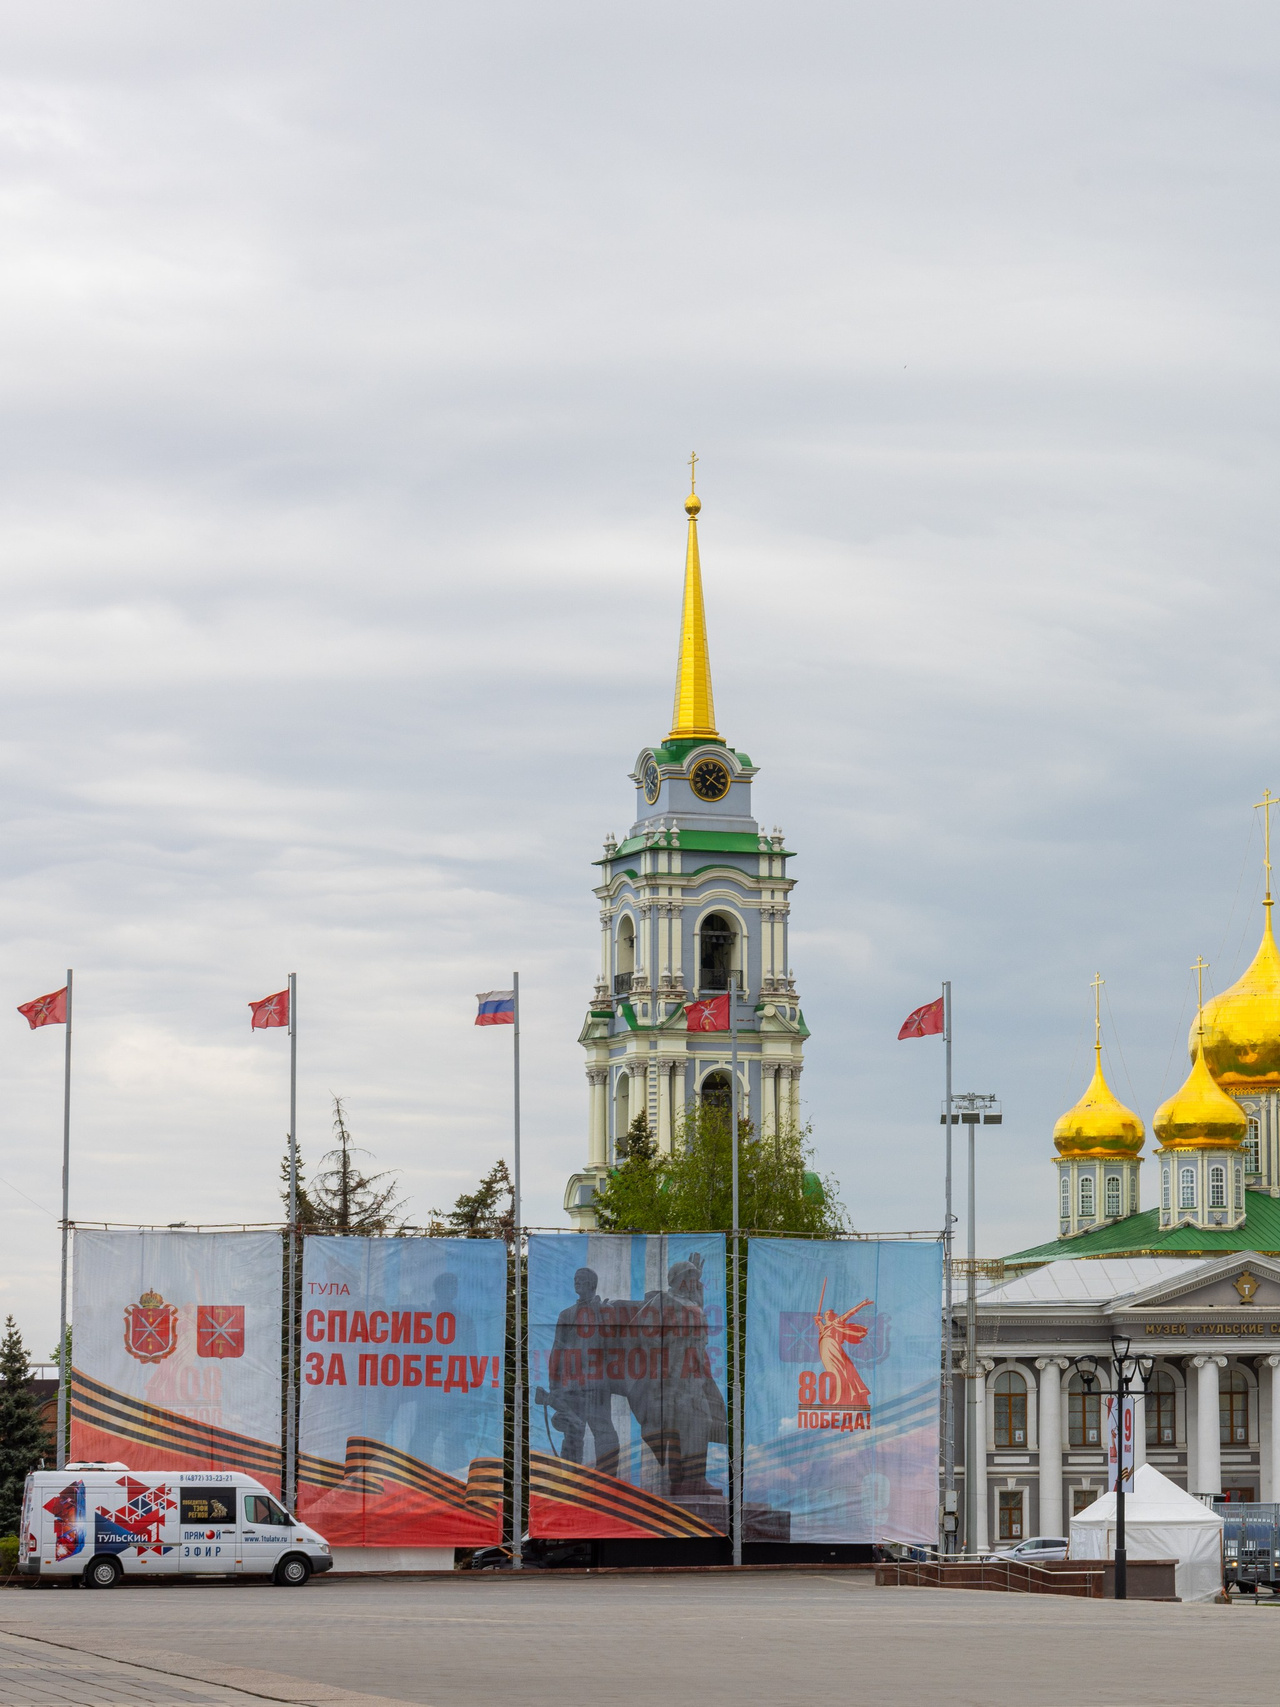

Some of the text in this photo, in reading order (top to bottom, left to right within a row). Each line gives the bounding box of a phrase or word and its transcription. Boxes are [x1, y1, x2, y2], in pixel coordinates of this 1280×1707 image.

[307, 1282, 350, 1295] ТУЛА
[306, 1309, 456, 1345] СПАСИБО
[1145, 1323, 1187, 1334] МУЗЕЙ
[1193, 1324, 1264, 1334] «ТУЛЬСКИЕ
[305, 1352, 500, 1394] ЗА ПОБЕДУ!
[798, 1370, 837, 1405] 80
[797, 1411, 871, 1433] ПОБЕДА!
[1124, 1408, 1132, 1442] 9
[97, 1533, 148, 1542] ТУЛЬСКИЙ
[184, 1546, 221, 1557] ЭФИР
